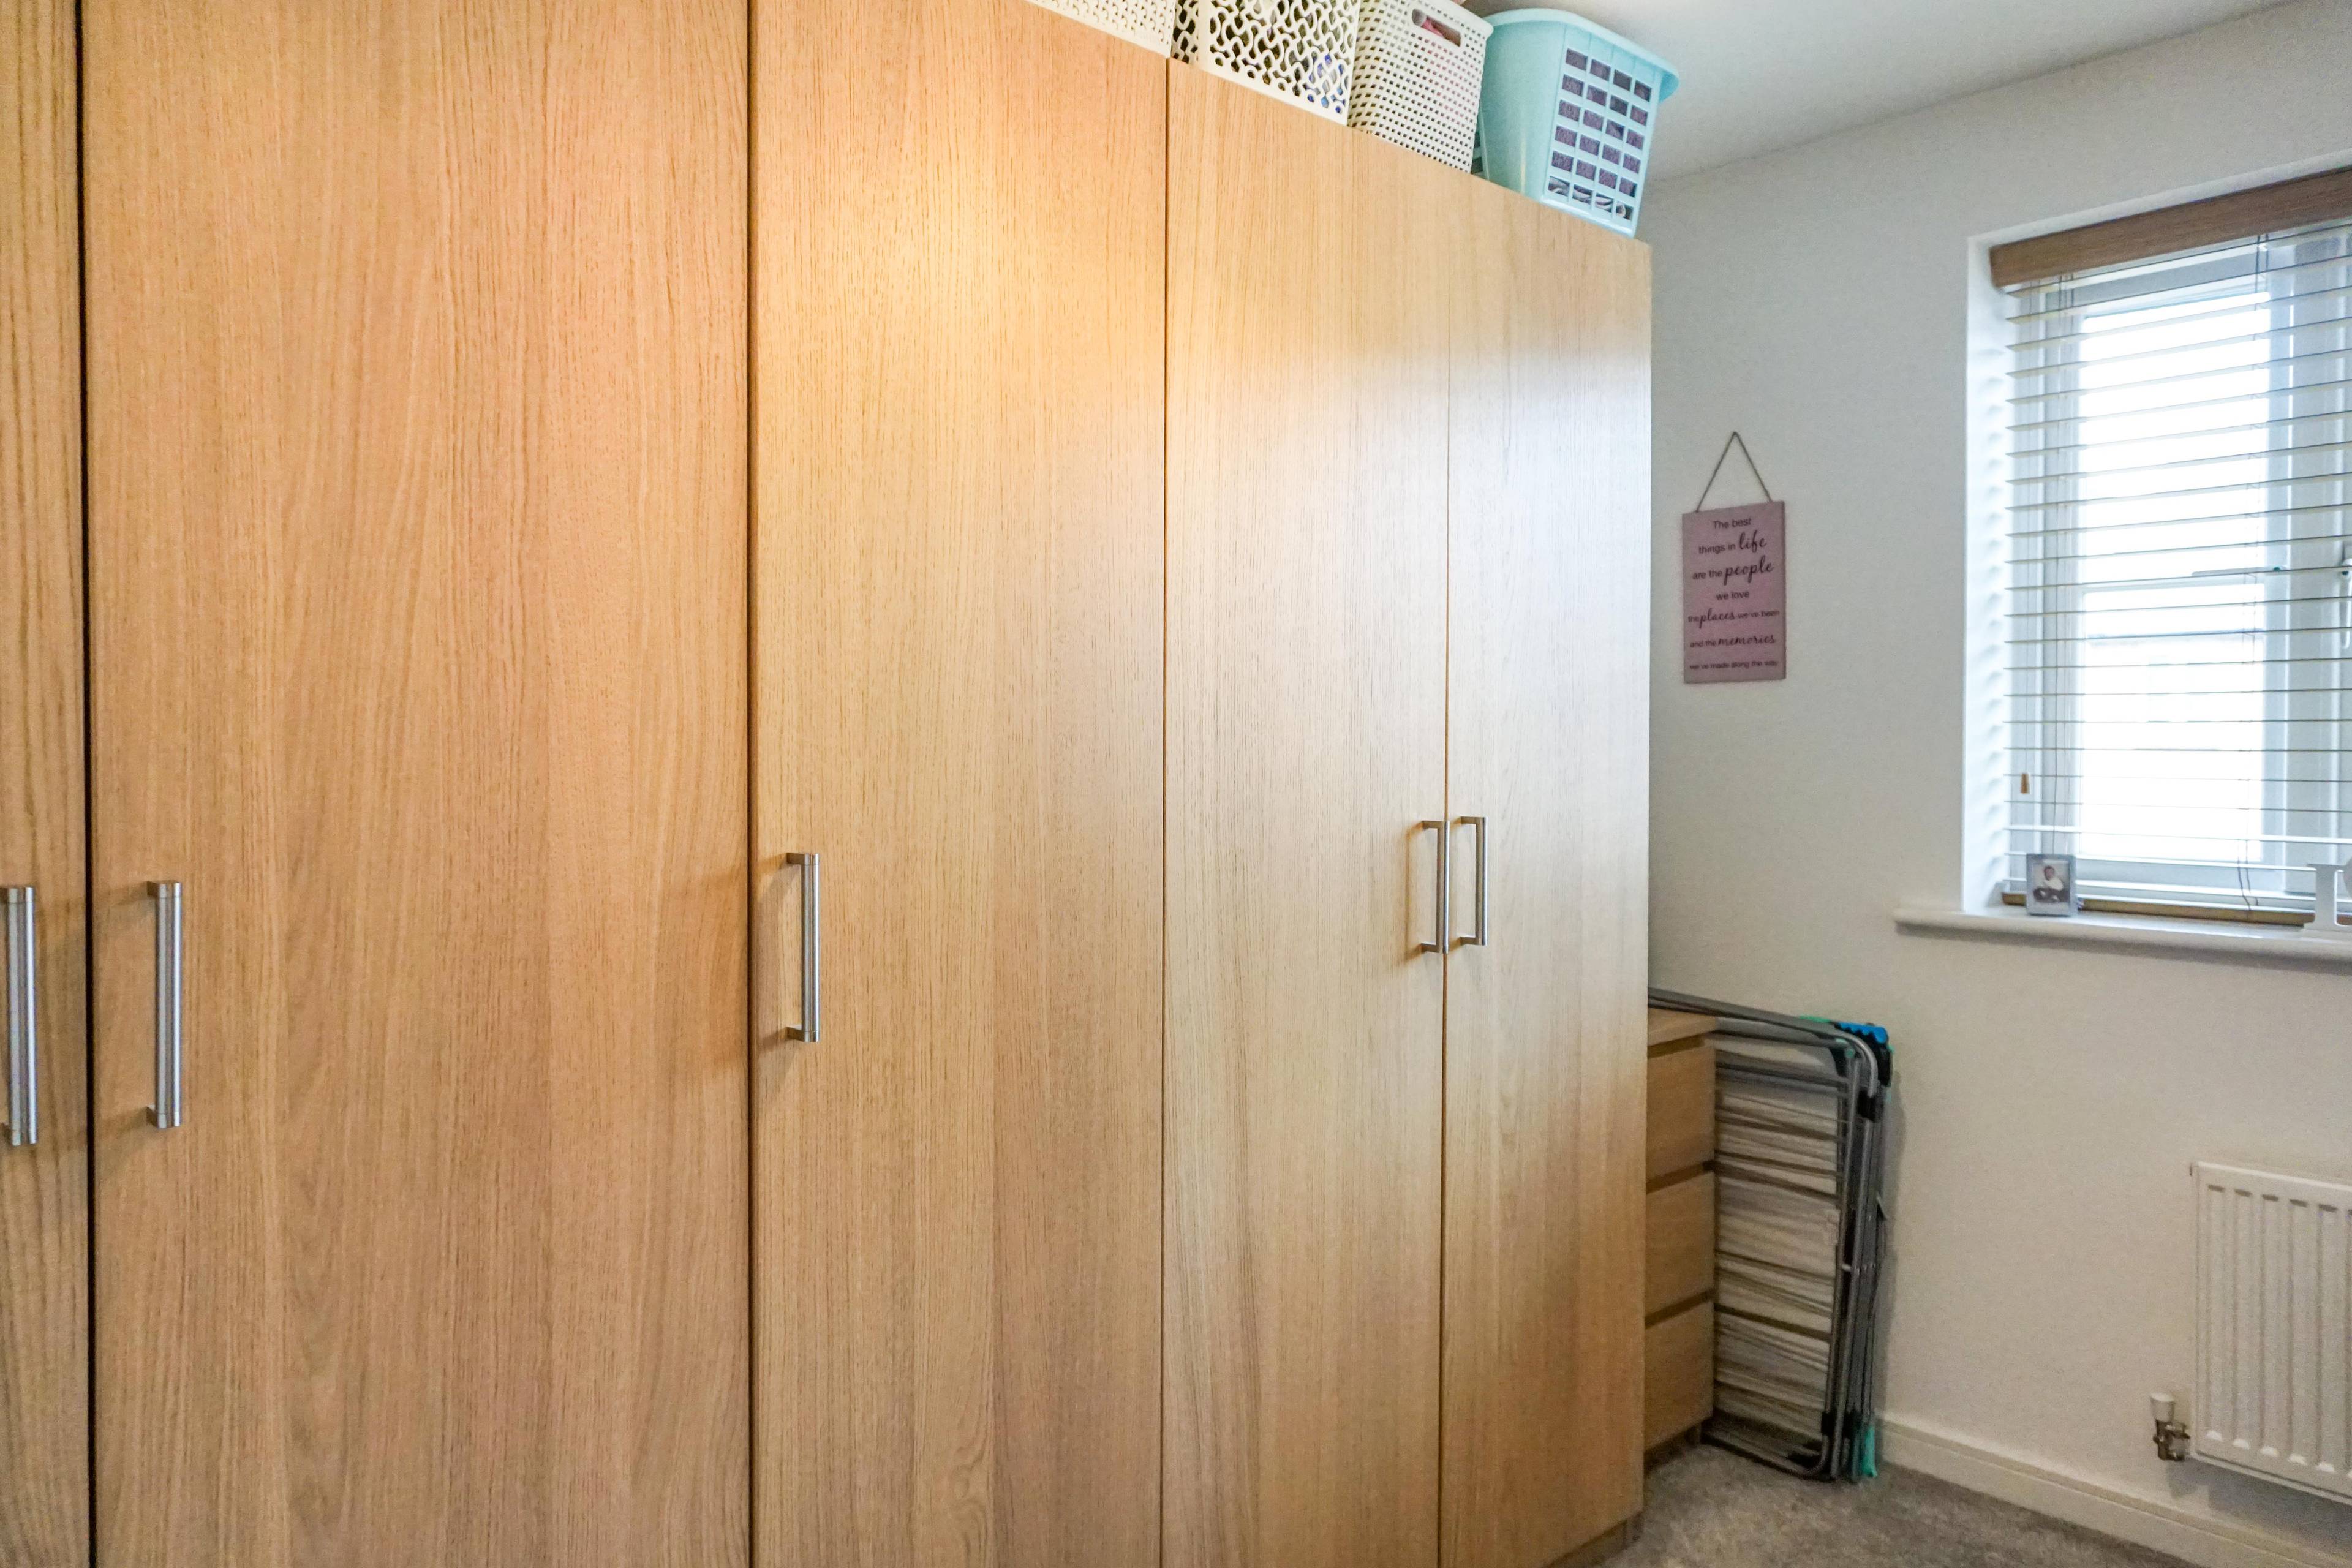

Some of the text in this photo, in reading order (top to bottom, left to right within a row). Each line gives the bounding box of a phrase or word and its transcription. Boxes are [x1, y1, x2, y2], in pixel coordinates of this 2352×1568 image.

[1732, 518, 1751, 527] best
[1698, 545, 1725, 554] things
[1740, 529, 1767, 553] life
[1724, 554, 1774, 586] people
[1699, 608, 1735, 629] places
[1717, 635, 1775, 646] memories
